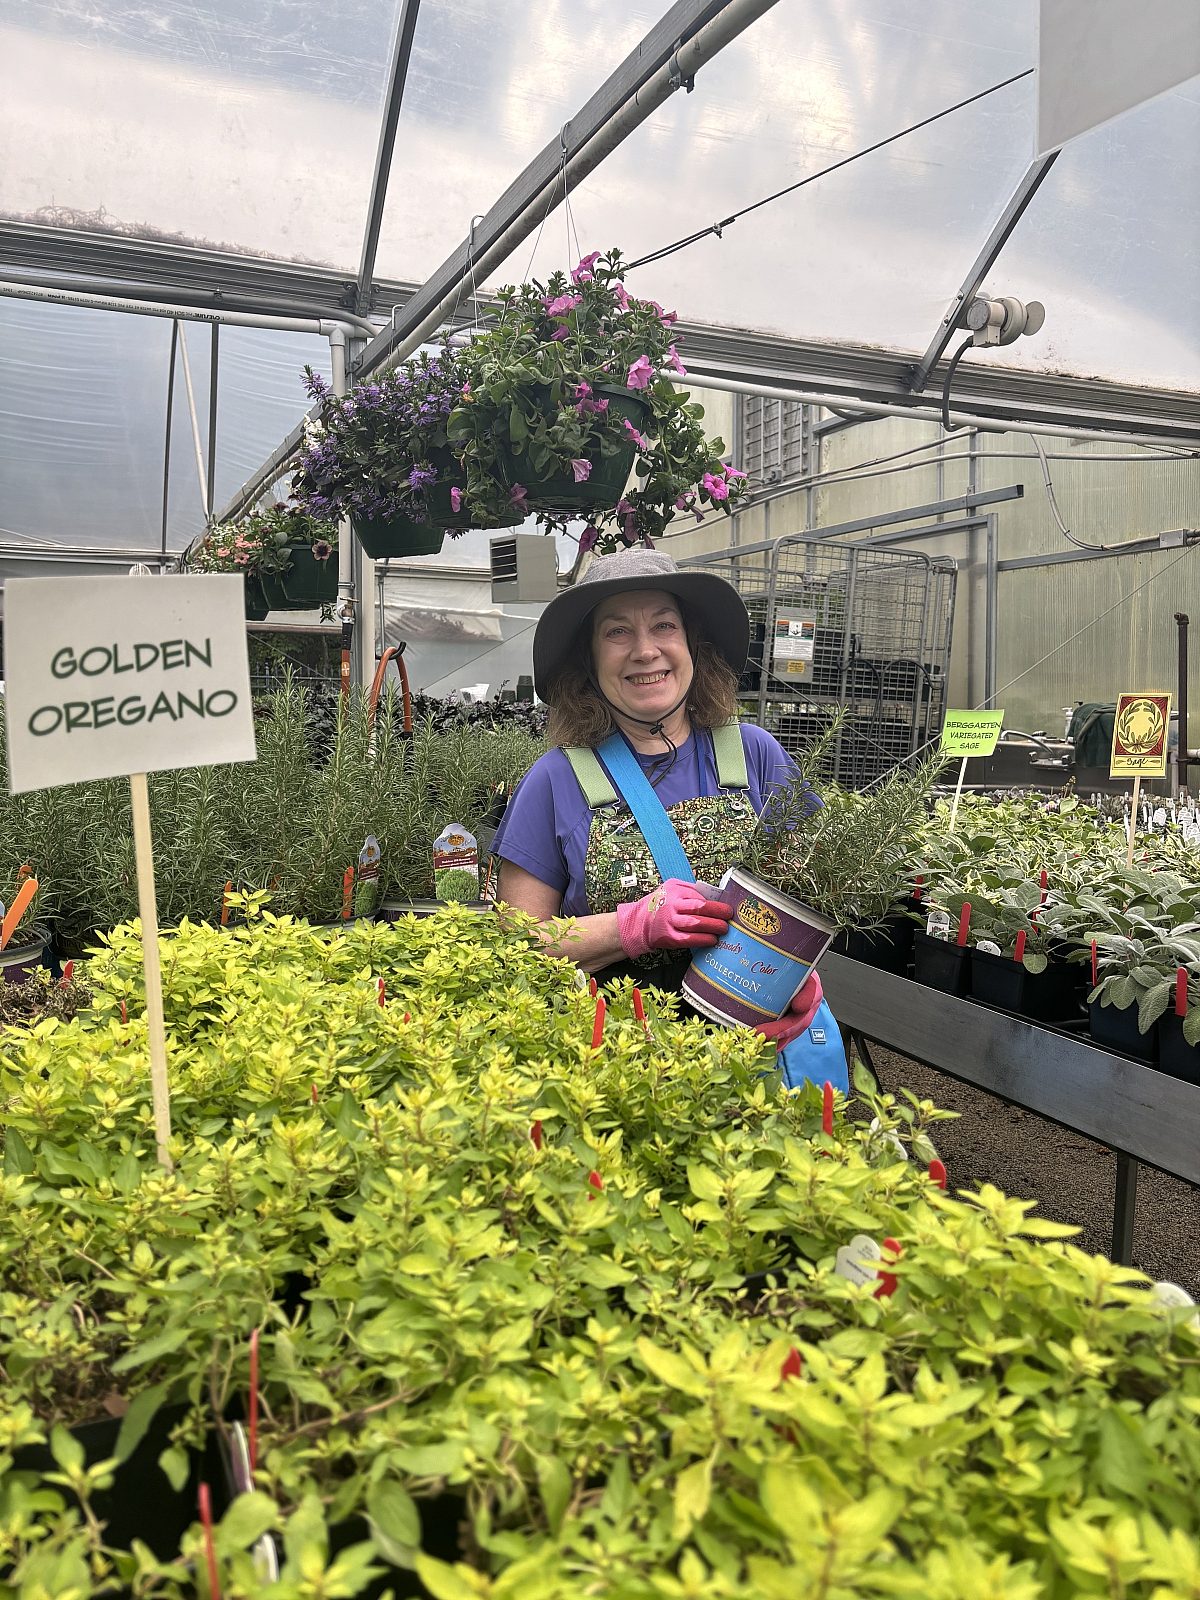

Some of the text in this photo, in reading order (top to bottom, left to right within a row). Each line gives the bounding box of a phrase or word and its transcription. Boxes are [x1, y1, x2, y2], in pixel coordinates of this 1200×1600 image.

[51, 638, 212, 679] GOLDEN
[28, 689, 238, 737] OREGANO
[946, 721, 1002, 729] BERGGARTEN
[950, 731, 994, 739] VARIEGATED
[1126, 757, 1149, 768] Sage
[739, 903, 778, 932] BRACY'S
[704, 952, 762, 993] COLLECTION
[750, 960, 779, 975] Color
